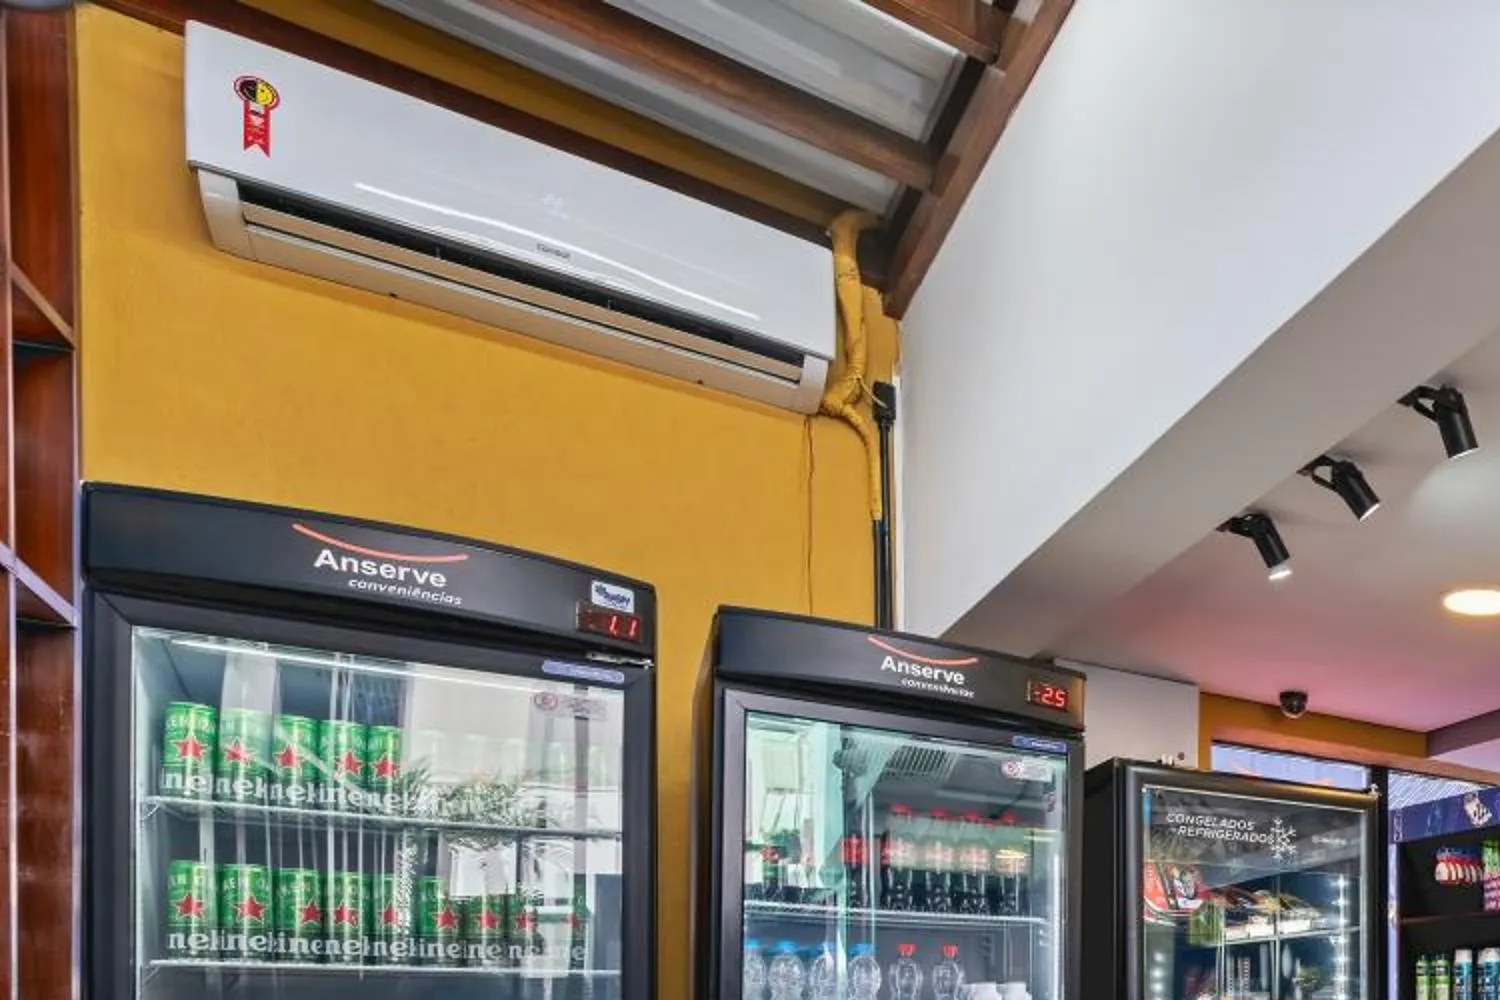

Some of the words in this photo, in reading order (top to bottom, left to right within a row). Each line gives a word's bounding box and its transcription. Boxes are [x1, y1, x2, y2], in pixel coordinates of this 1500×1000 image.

[314, 548, 447, 588] Anserve
[348, 577, 462, 605] conveniências
[881, 656, 965, 684] Anserve
[1166, 813, 1255, 831] CONGELADOS
[1178, 826, 1275, 845] REFRIGERADOS
